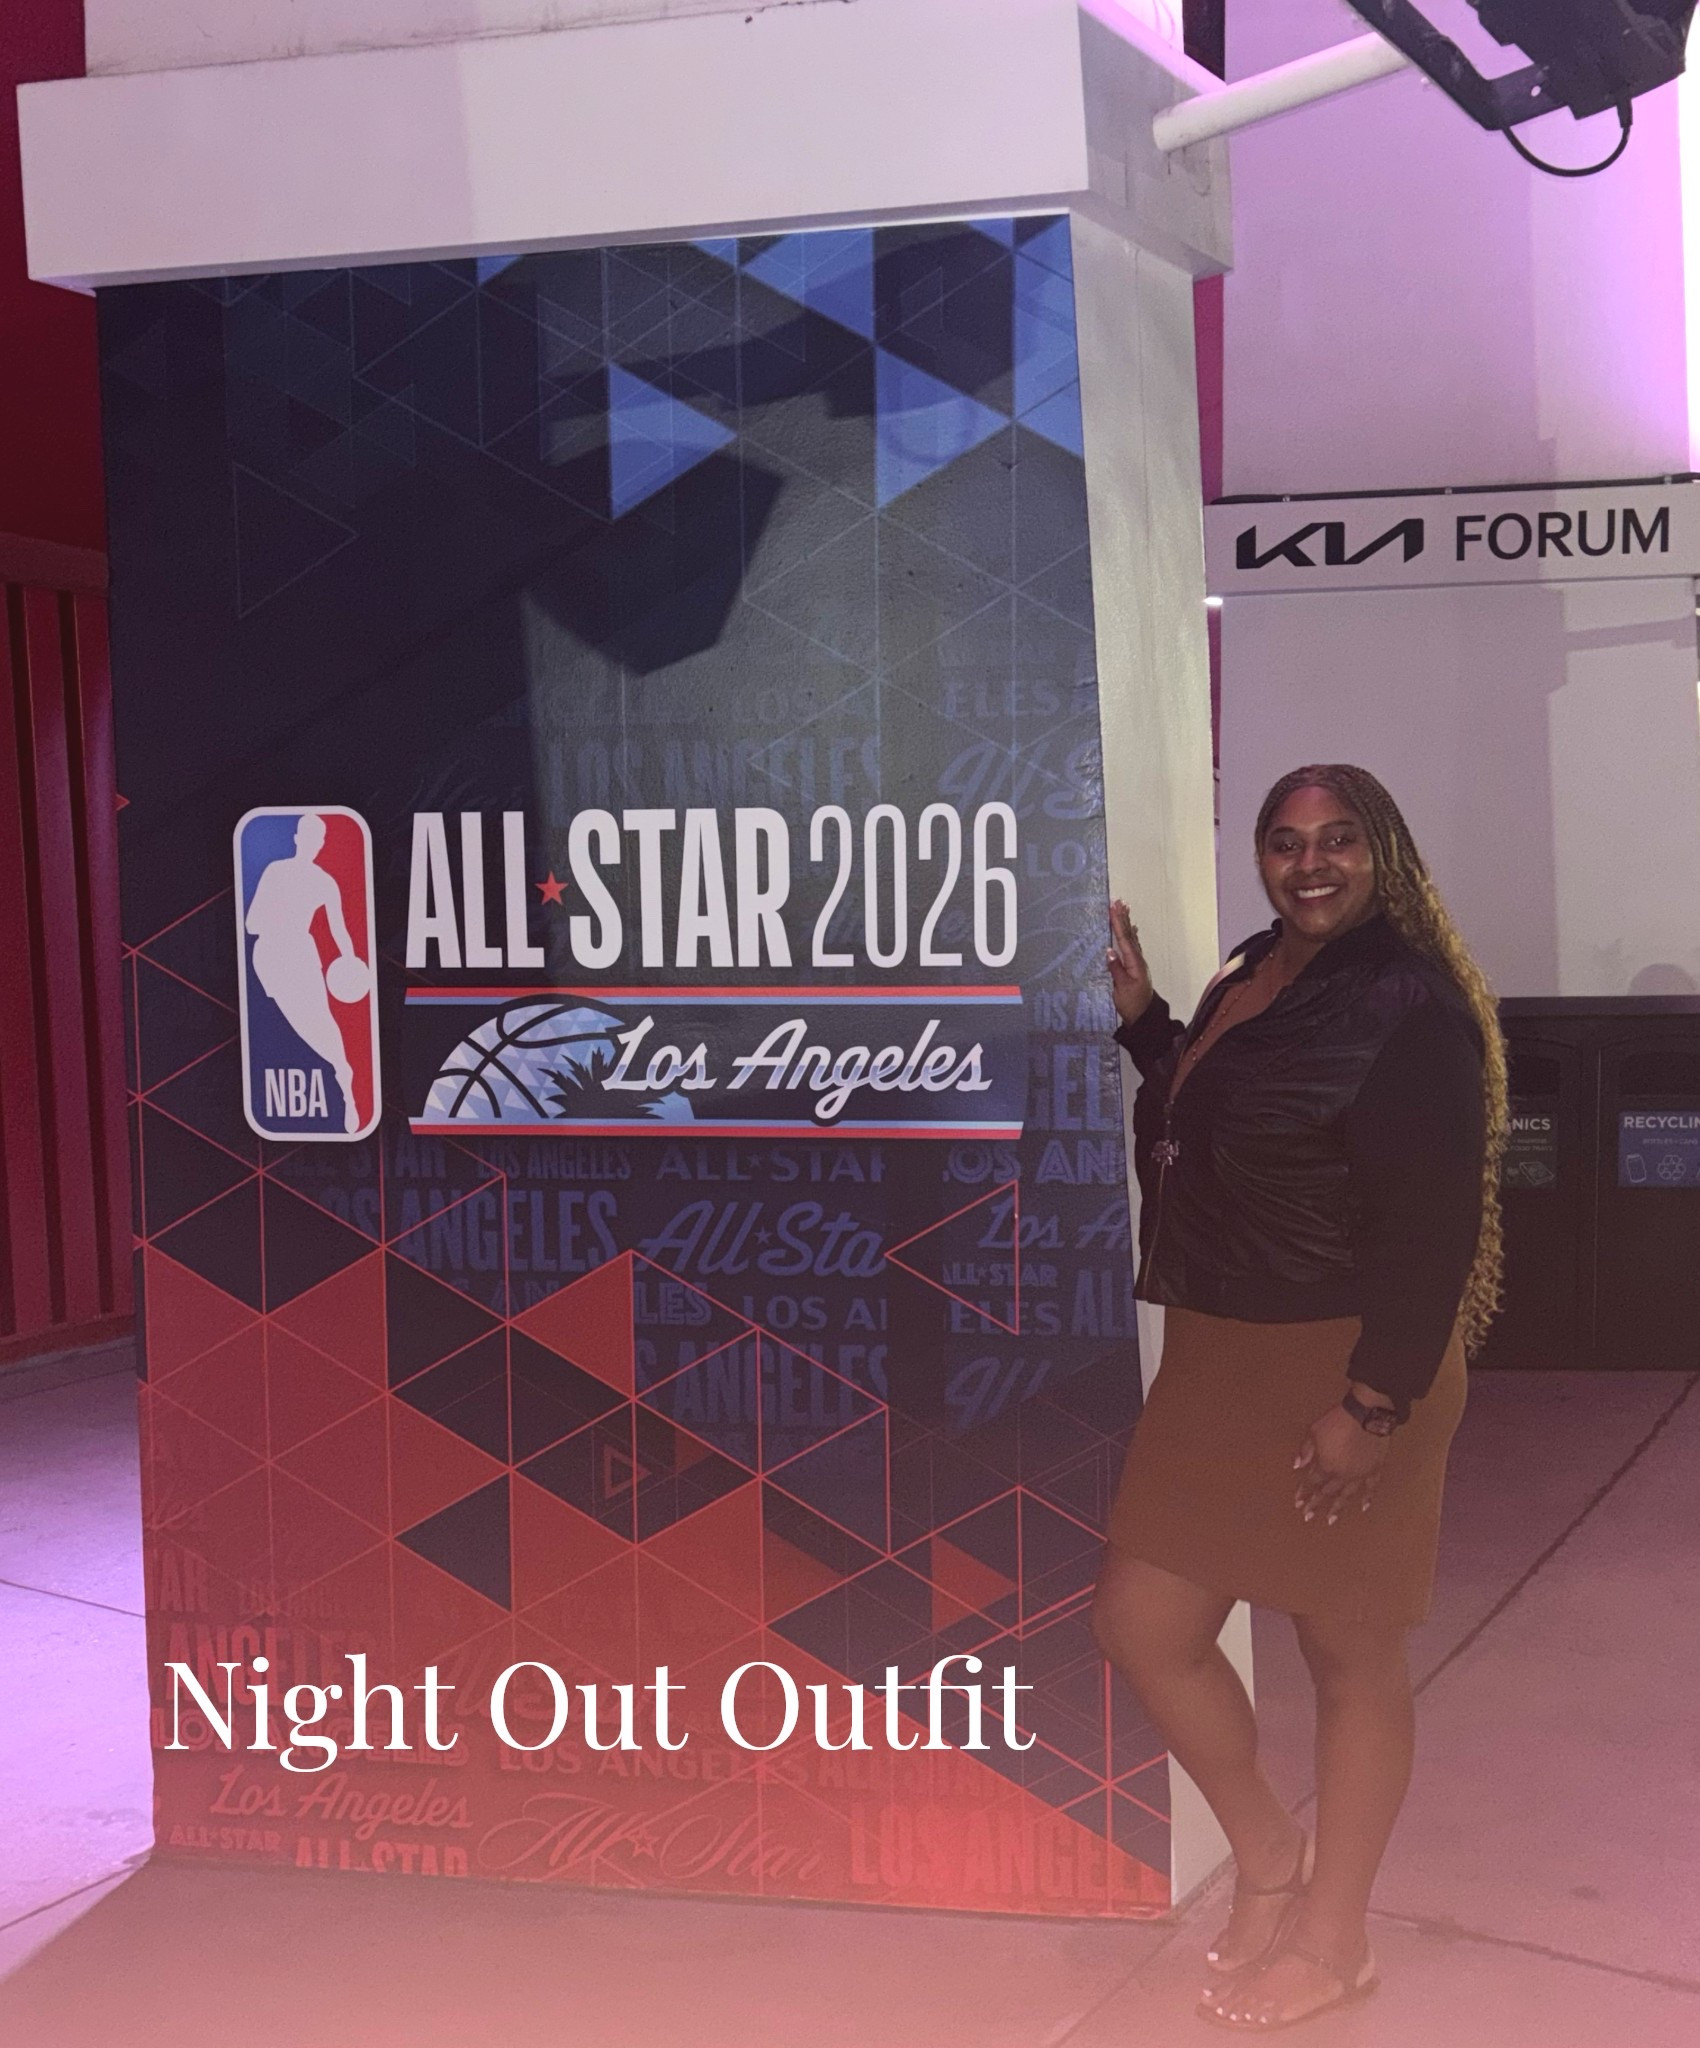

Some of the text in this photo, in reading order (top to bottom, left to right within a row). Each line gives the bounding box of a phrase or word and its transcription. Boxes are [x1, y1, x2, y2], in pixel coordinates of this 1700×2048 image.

[1455, 505, 1670, 561] FORUM
[405, 810, 546, 969] ALL
[568, 807, 793, 970] STAR
[809, 801, 1018, 969] 2026
[264, 1068, 329, 1118] NBA
[602, 1015, 993, 1120] Los Angeles
[209, 1764, 474, 1841] Los Angeles
